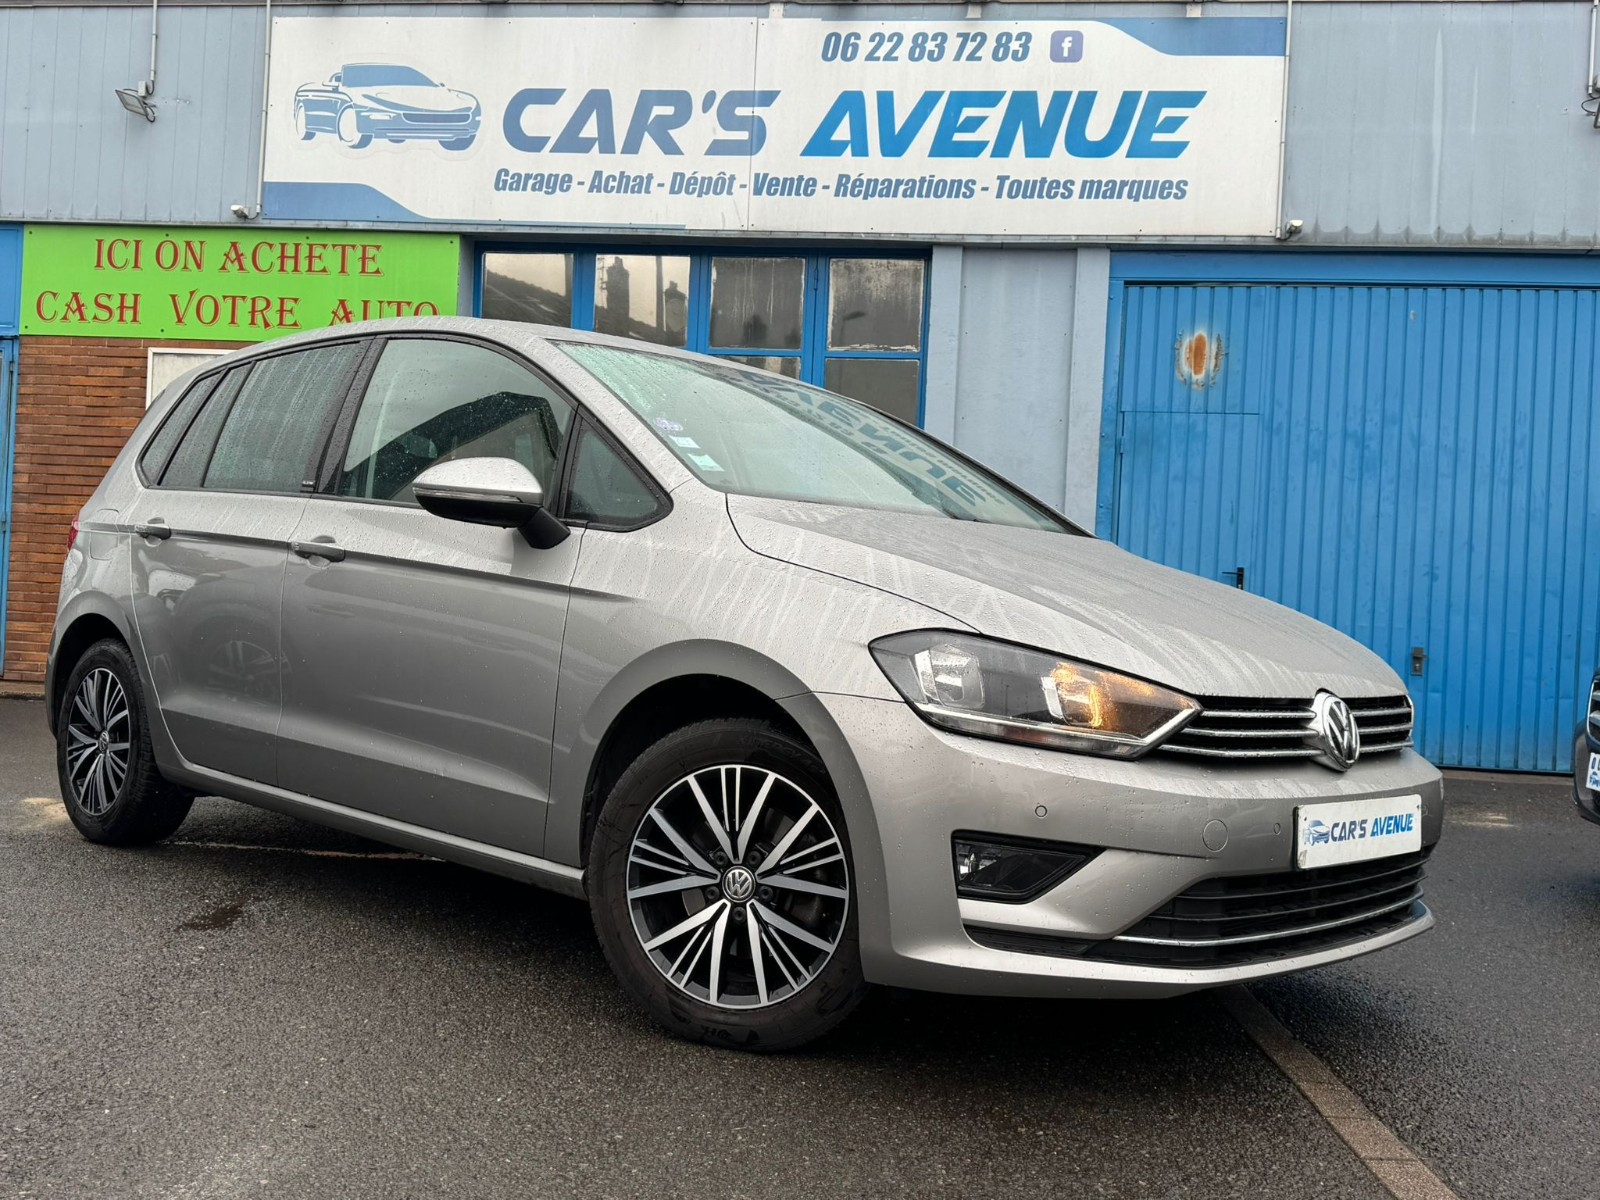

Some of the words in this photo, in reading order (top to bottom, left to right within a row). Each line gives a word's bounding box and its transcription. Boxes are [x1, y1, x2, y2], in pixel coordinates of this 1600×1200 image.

[821, 32, 861, 62] 06
[865, 32, 905, 62] 22
[908, 32, 948, 63] 83
[953, 32, 987, 62] 72
[992, 32, 1033, 63] 83
[502, 88, 781, 157] CAR'S
[800, 90, 1208, 159] AVENUE
[494, 167, 573, 196] Garage
[588, 171, 655, 195] Achat
[669, 171, 736, 199] Dépôt
[752, 173, 817, 198] Vente
[834, 173, 977, 200] Réparations
[995, 175, 1076, 200] Toutes
[1078, 179, 1189, 202] marques
[94, 238, 143, 271] ICI
[155, 240, 207, 272] ON
[218, 241, 385, 277] ACHETE
[36, 290, 142, 324] CASH
[169, 288, 302, 331] VOTRE
[1330, 819, 1368, 842] CAR'S
[1370, 813, 1415, 838] AVENUE
